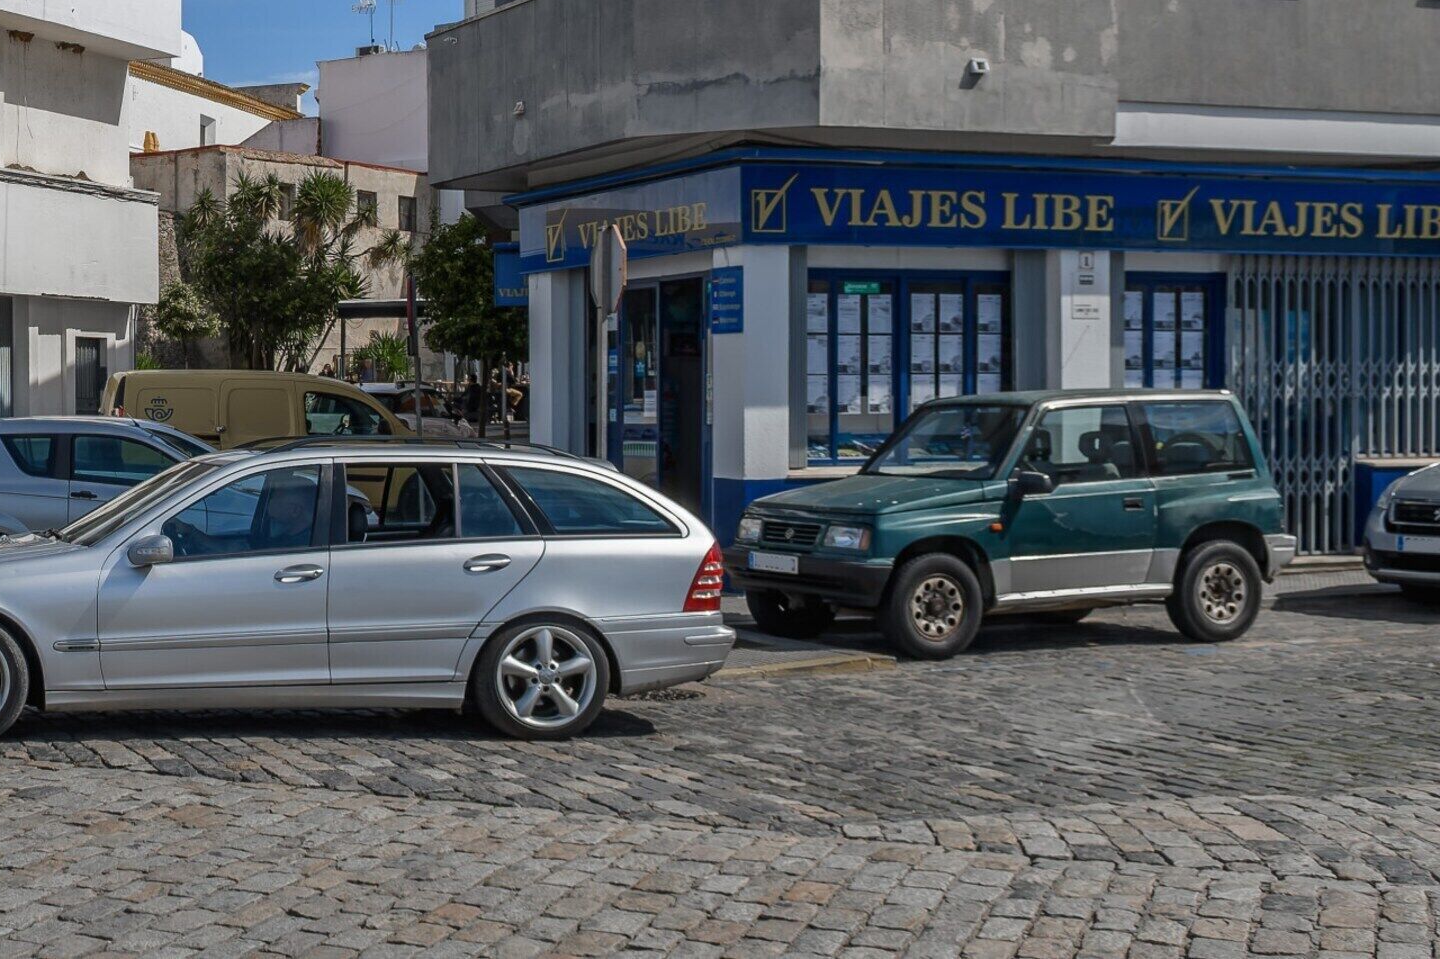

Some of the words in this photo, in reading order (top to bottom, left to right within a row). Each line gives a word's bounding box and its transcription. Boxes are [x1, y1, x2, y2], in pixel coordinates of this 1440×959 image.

[654, 202, 708, 238] LIBE
[810, 188, 987, 229] VIAJES
[1001, 192, 1115, 232] LIBE
[1209, 198, 1364, 239] VIAJES
